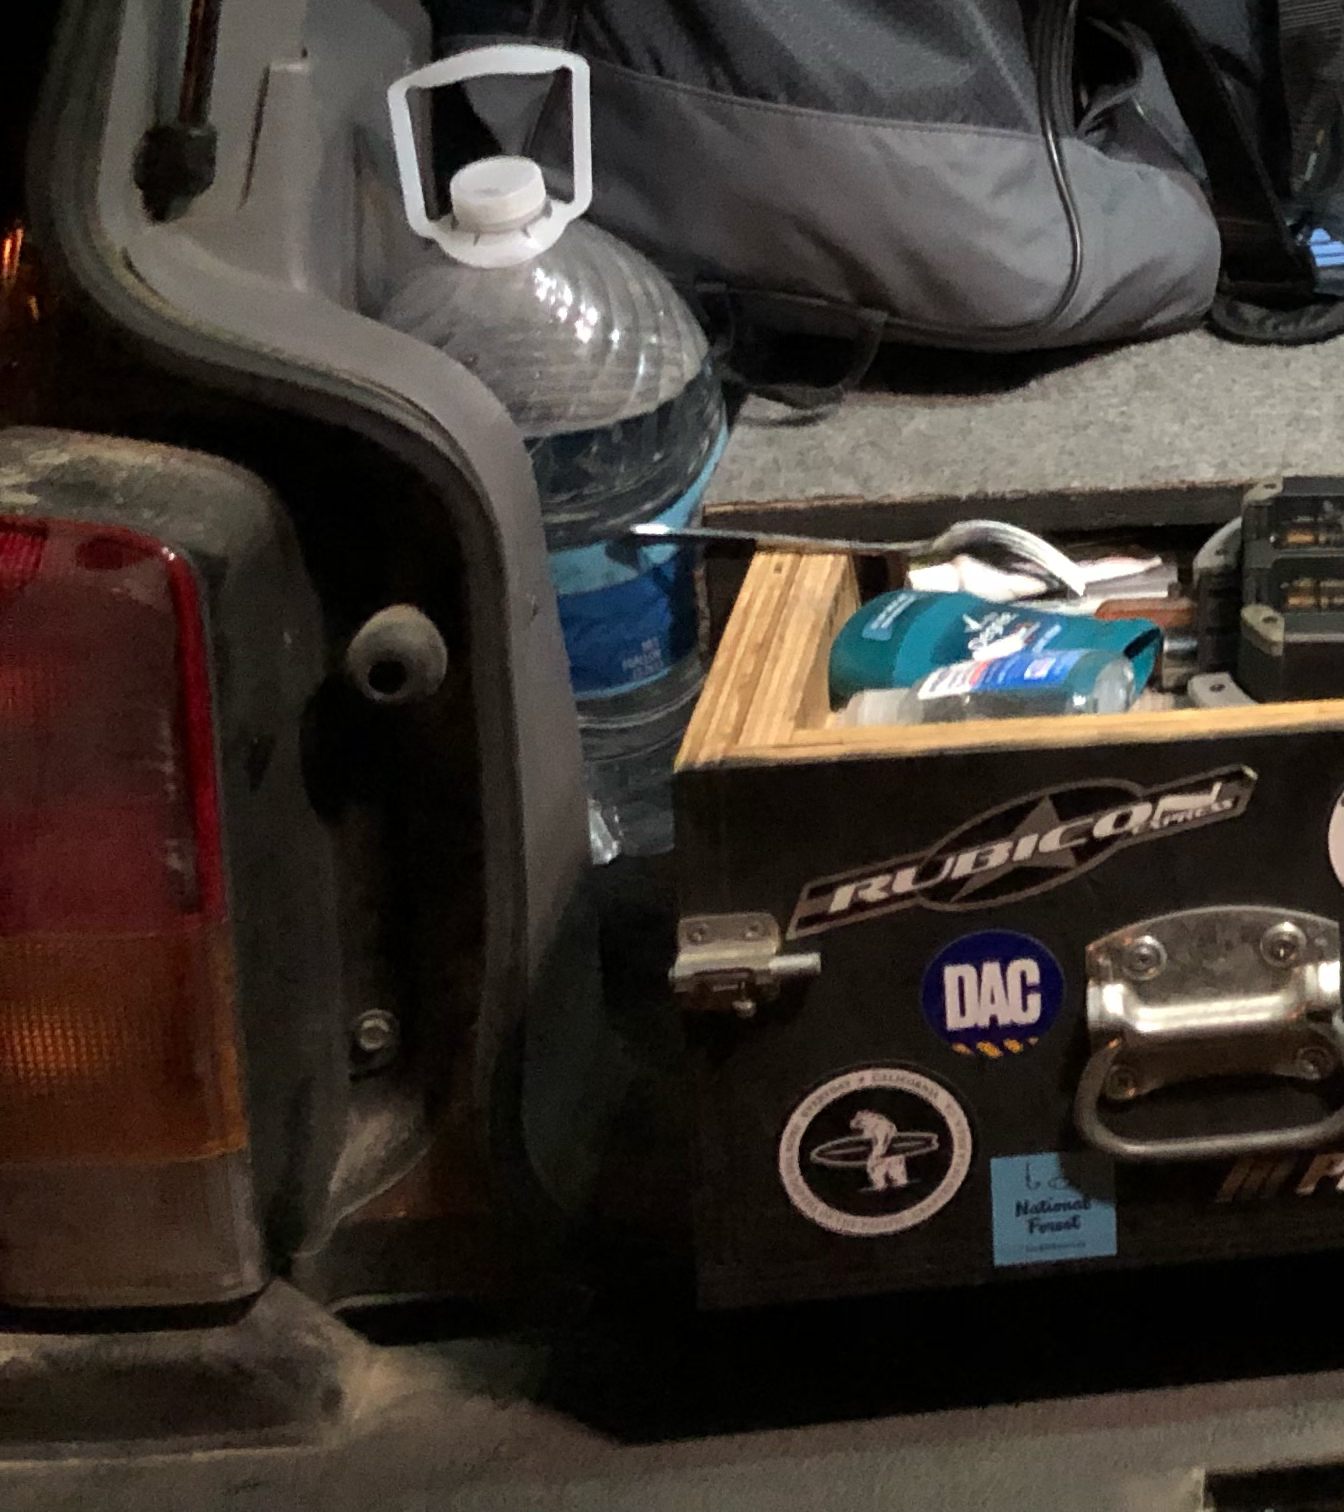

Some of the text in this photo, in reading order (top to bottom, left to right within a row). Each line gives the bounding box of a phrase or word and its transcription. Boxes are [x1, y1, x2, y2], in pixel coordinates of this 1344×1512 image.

[828, 781, 1222, 914] RUBICON
[943, 957, 1042, 1032] DAC
[1015, 1198, 1091, 1218] National
[1027, 1214, 1081, 1234] Forest
